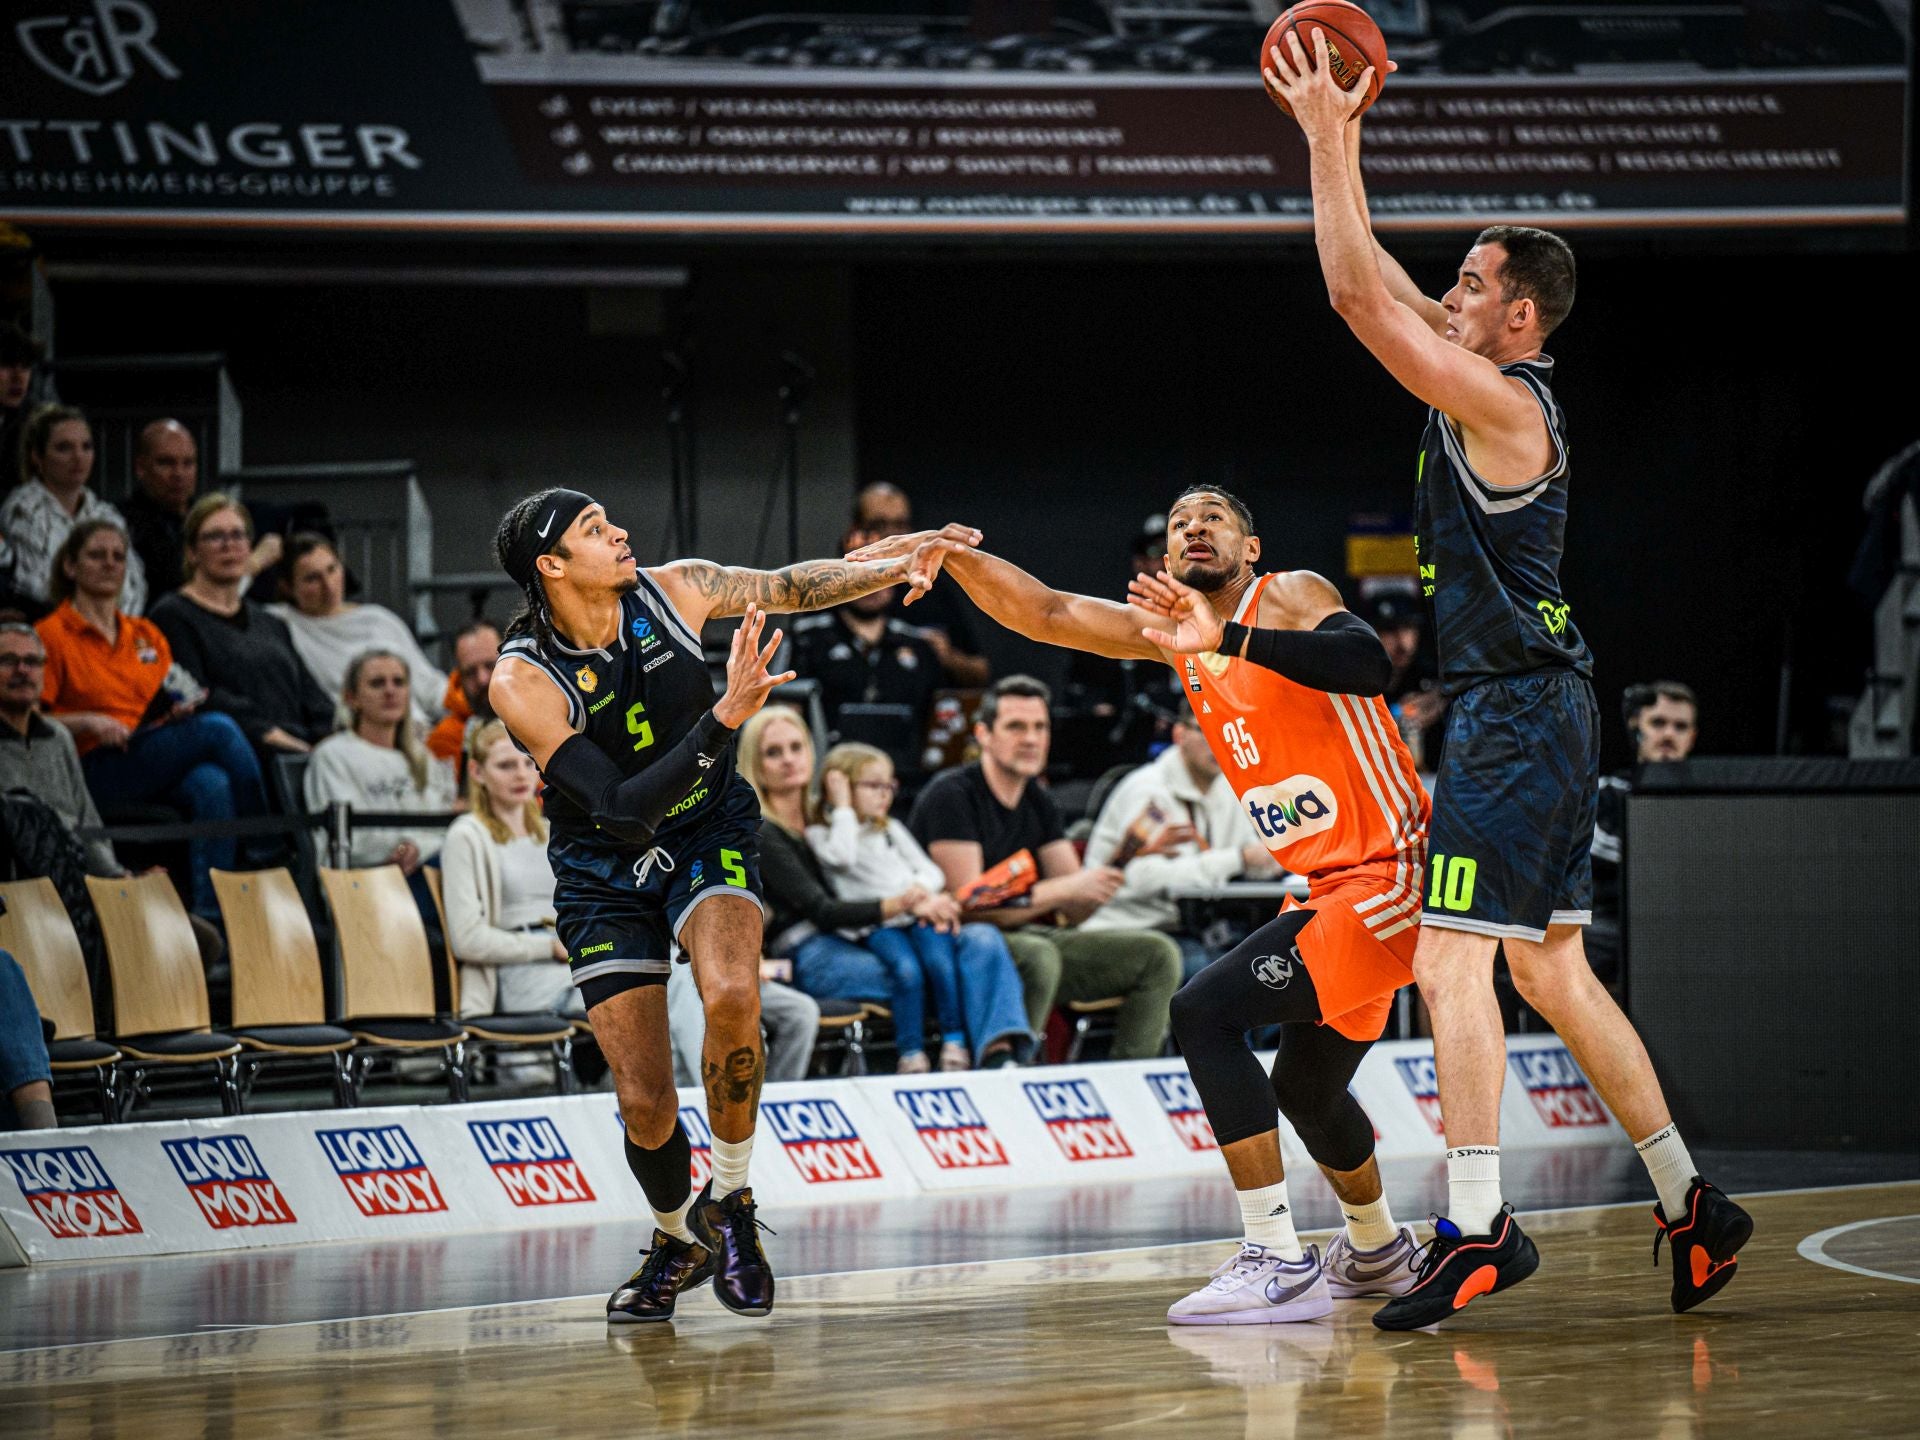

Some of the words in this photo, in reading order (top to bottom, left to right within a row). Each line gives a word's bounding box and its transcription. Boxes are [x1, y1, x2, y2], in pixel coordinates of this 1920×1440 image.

[0, 119, 421, 169] TTINGER
[626, 702, 656, 752] 5
[1222, 717, 1261, 770] 35
[665, 787, 708, 817] anaria
[1250, 789, 1330, 838] teva
[720, 848, 747, 888] 5
[1428, 854, 1478, 912] 10
[580, 941, 614, 957] SPALDING
[897, 1090, 984, 1128] LIQUI
[1025, 1081, 1107, 1121] LIQUI
[1148, 1074, 1202, 1112] LIQ
[472, 1120, 566, 1163] LIQUI
[766, 1102, 853, 1143] LIQUI
[1049, 1119, 1128, 1158] MOLY
[168, 1137, 264, 1182] LIQUI
[321, 1126, 419, 1172] LIQUI
[788, 1140, 877, 1181] MOLY
[920, 1128, 1005, 1167] MOLY
[5, 1149, 109, 1192] LIQUI
[345, 1168, 440, 1213] MOLY
[496, 1162, 588, 1204] MOLY
[31, 1192, 137, 1236] MOLY
[194, 1182, 287, 1227] MOLY
